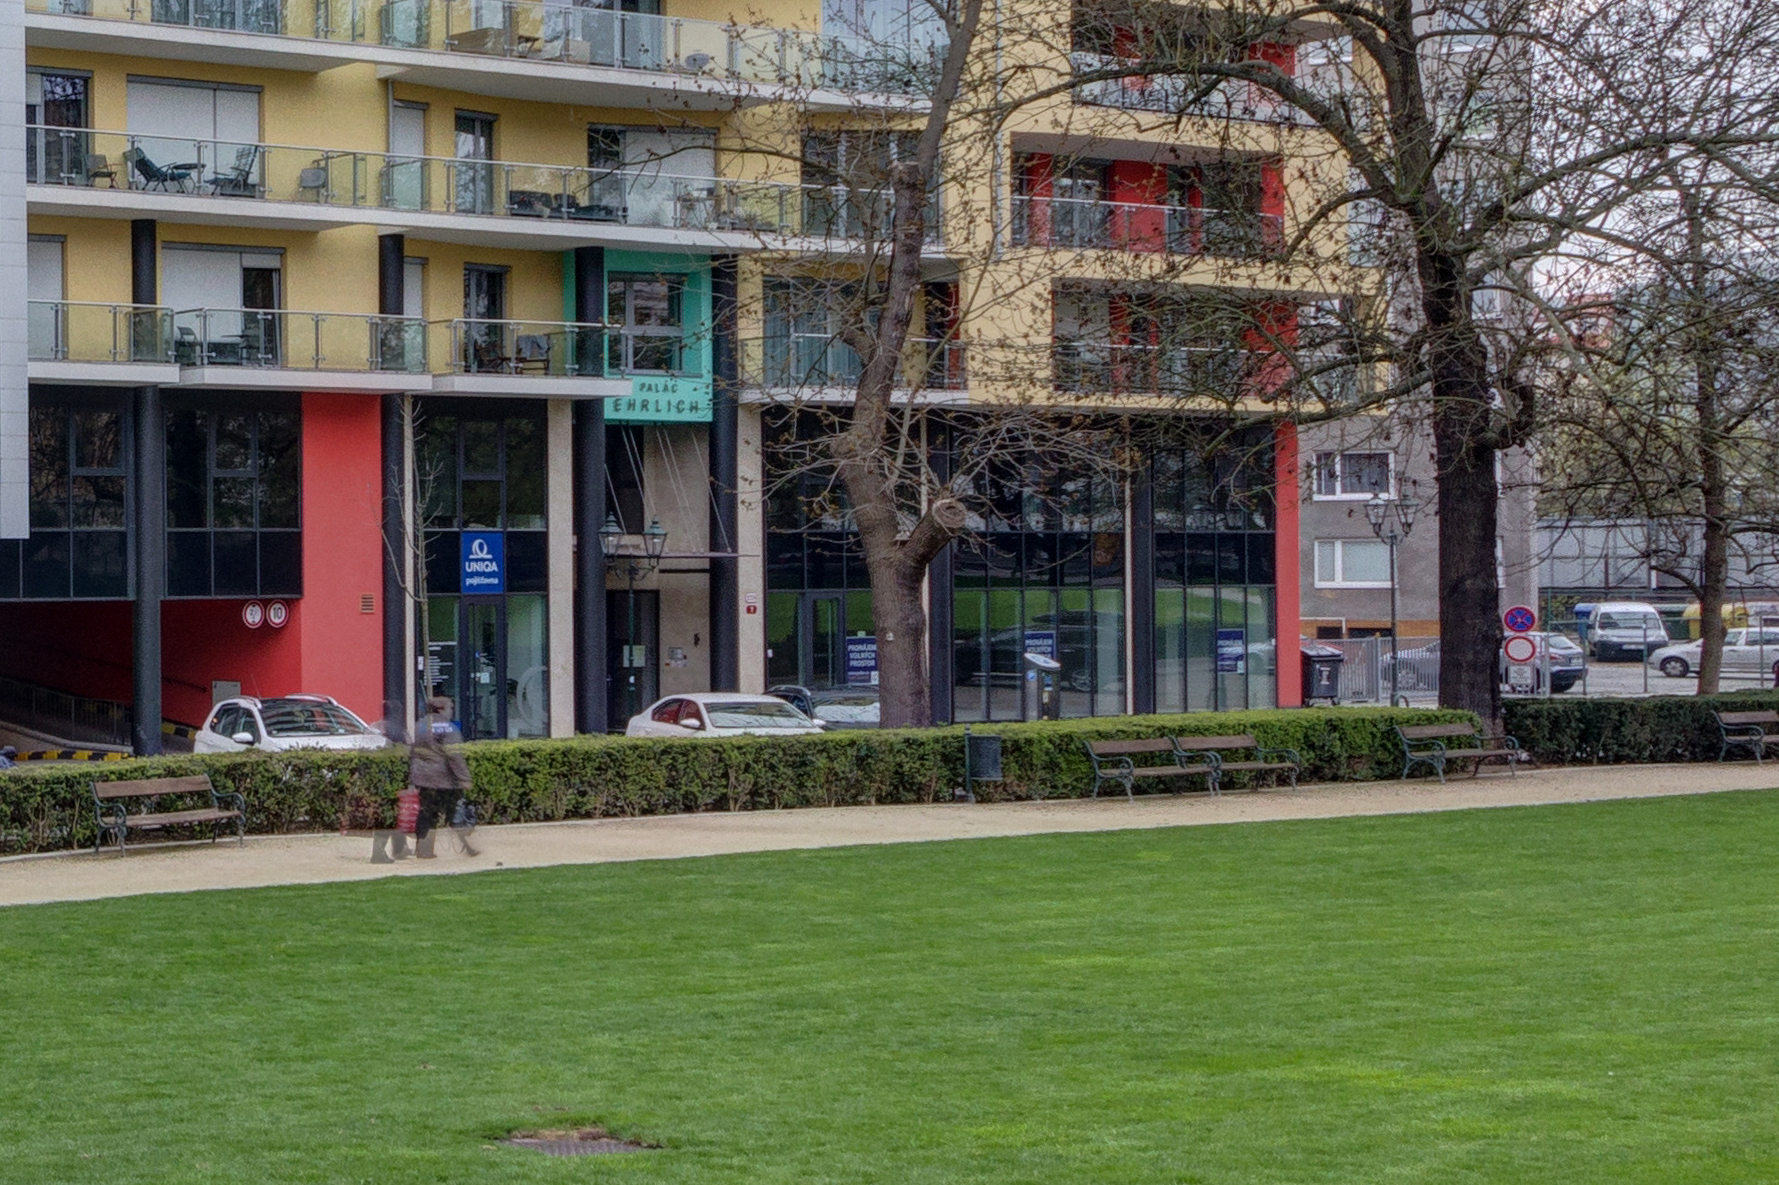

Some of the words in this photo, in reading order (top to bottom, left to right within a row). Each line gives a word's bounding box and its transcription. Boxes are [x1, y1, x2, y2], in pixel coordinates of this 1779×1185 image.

[613, 398, 700, 414] EHRLICH
[465, 561, 499, 572] UNIQA
[273, 607, 283, 620] 10
